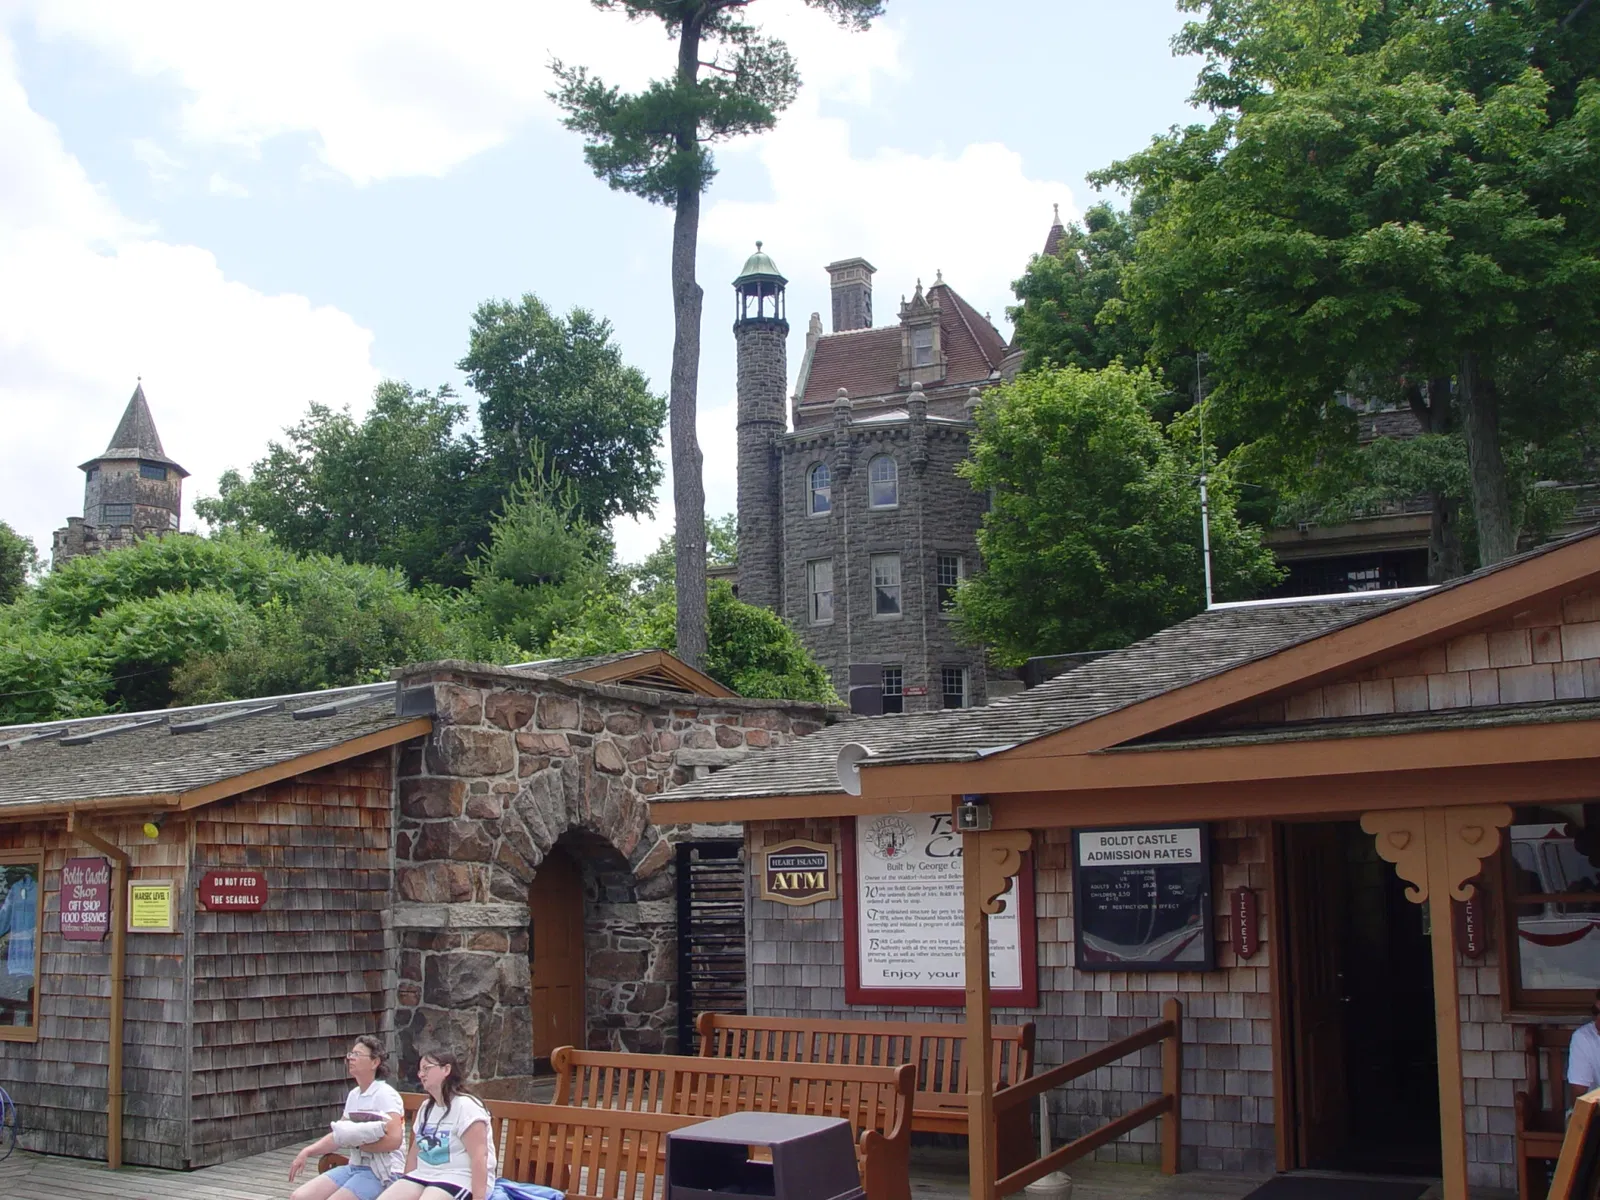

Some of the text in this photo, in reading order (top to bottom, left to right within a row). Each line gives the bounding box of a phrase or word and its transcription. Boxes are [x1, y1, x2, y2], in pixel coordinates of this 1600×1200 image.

[1100, 834, 1177, 846] BOLDT CASTLE
[1088, 848, 1192, 861] ADMISSION RATES
[887, 861, 960, 872] Built by George C.
[63, 866, 108, 885] Boldt Castle
[771, 872, 825, 890] ATM
[214, 878, 256, 886] DO NOT FEED
[73, 885, 97, 899] Shop
[153, 892, 165, 900] LEVEL
[68, 900, 100, 911] GIFT SHOP
[211, 895, 259, 904] THE SEAGULLS
[62, 911, 107, 923] FOOD SERVICE
[1240, 893, 1248, 953] TICKETS
[1466, 900, 1475, 951] ICKETS
[882, 969, 961, 980] Enjoy your
